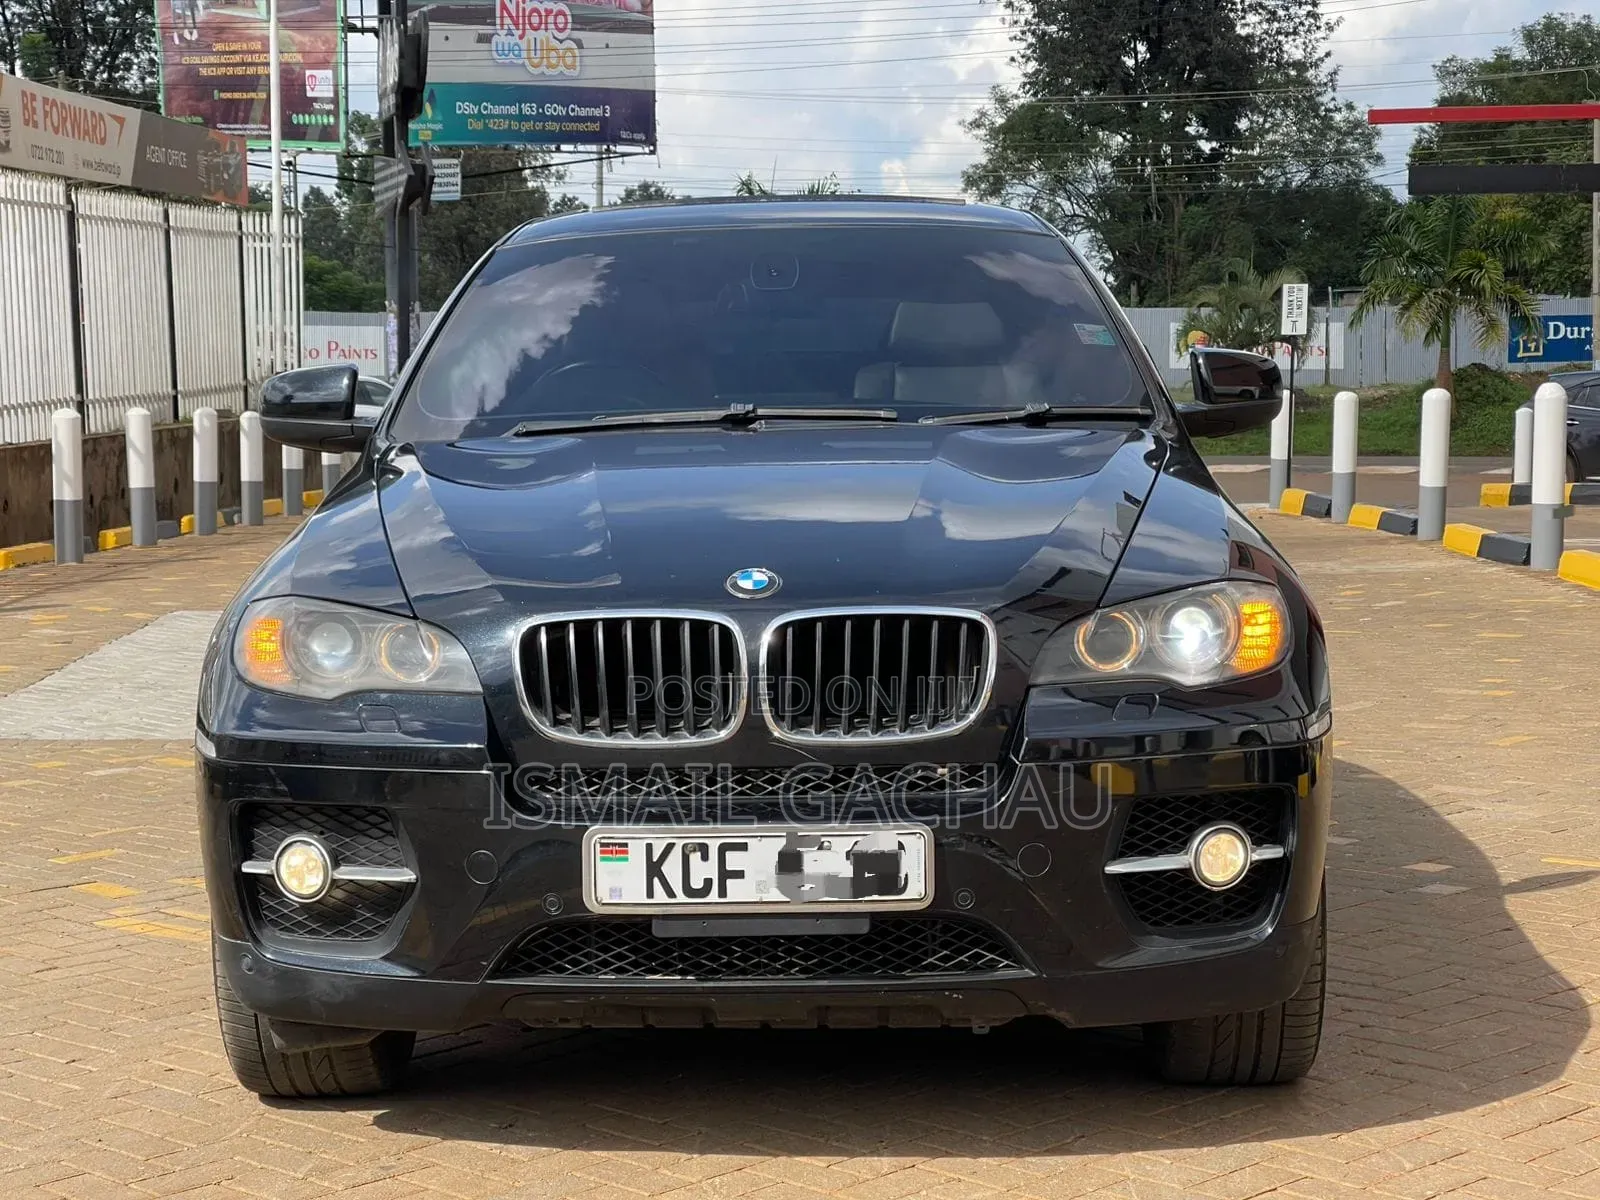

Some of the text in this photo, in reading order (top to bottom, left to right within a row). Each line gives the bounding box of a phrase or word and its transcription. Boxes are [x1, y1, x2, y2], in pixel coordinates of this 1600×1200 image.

[499, 0, 569, 40] Njoro
[495, 35, 577, 71] wa Uba
[21, 89, 107, 146] BE FORWARD
[455, 101, 611, 117] DStv Channel 163 GOtv Channel 3
[467, 119, 484, 130] Dial
[511, 120, 519, 130] to
[520, 120, 534, 132] get
[535, 122, 543, 130] or
[544, 120, 560, 133] stay
[561, 121, 601, 132] connected
[145, 145, 165, 164] AGENT
[167, 149, 187, 169] OFFICE
[1287, 285, 1296, 319] THANK YOU
[1295, 297, 1304, 311] NEXT
[1547, 321, 1594, 340] Dur
[645, 842, 749, 899] KCF
